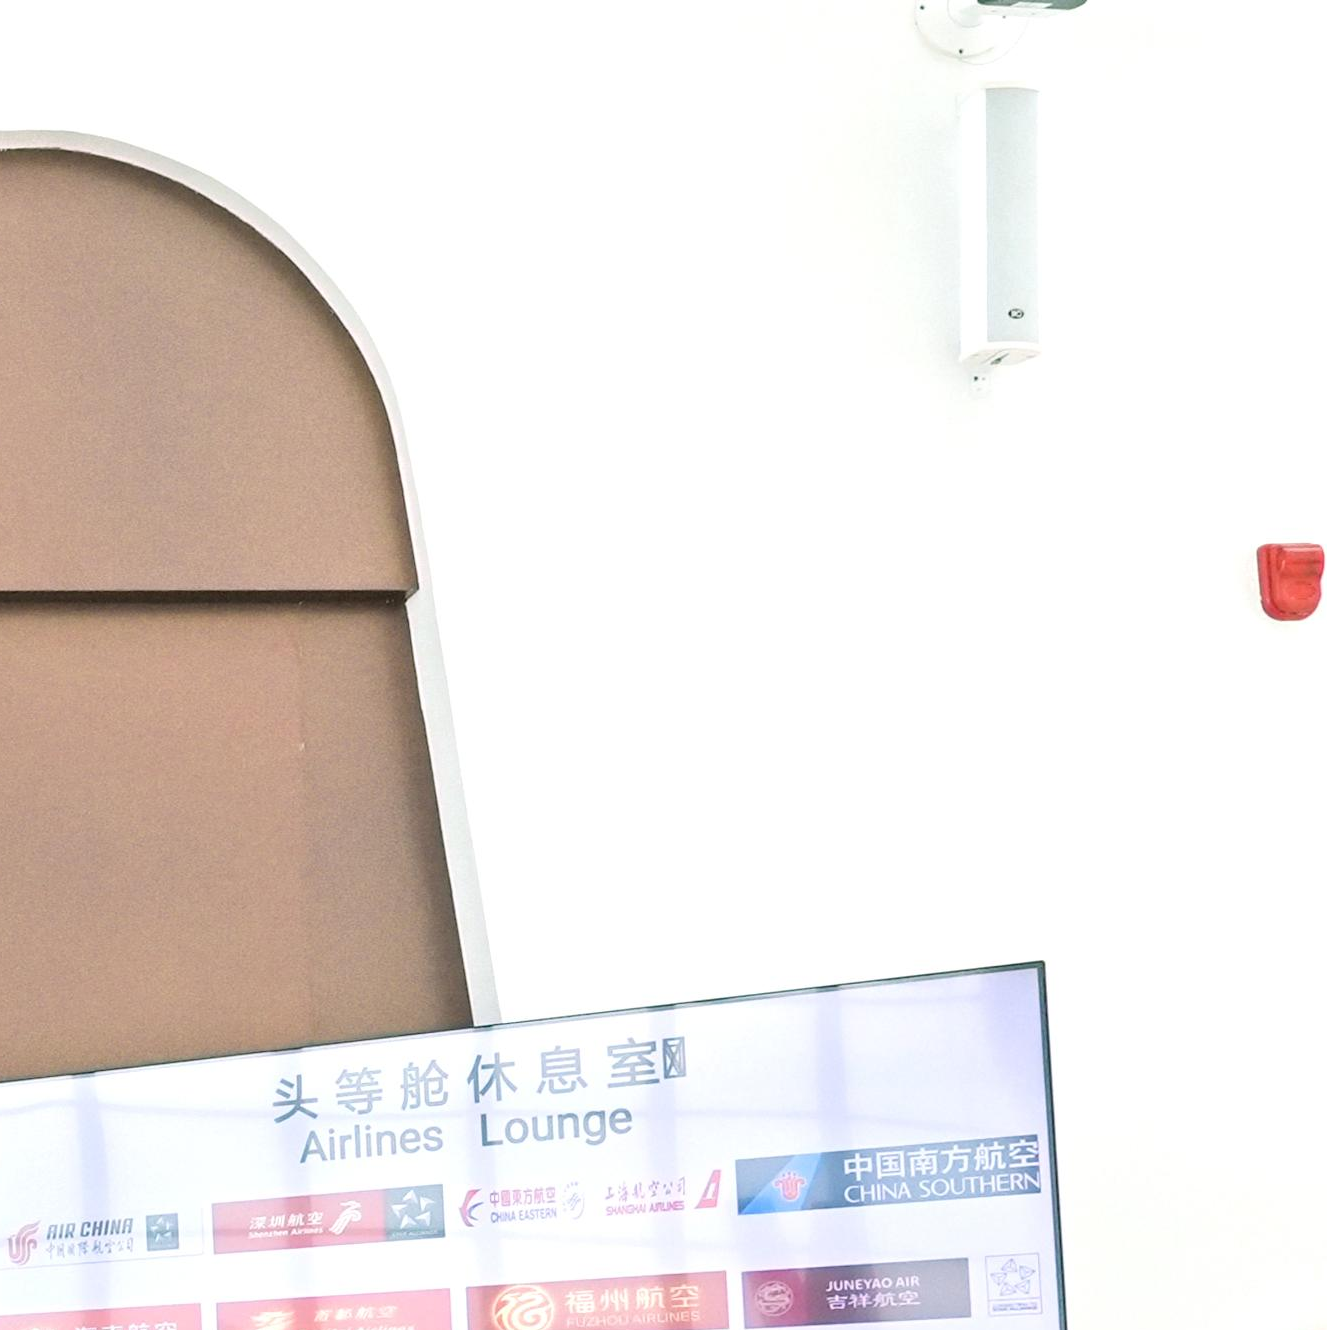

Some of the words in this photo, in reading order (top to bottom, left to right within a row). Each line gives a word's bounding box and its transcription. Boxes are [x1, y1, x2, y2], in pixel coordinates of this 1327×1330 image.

[273, 1037, 660, 1124] 头等舱休息室
[299, 1124, 444, 1164] Airlines
[479, 1107, 633, 1147] Lounge
[843, 1139, 1040, 1182] 中国南方航空
[844, 1182, 912, 1204] CHINA
[918, 1171, 1040, 1198] SOUTHERN
[249, 1210, 324, 1231] 深圳航空
[489, 1210, 517, 1224] CHINA
[518, 1207, 558, 1221] EASTERN
[605, 1203, 647, 1217] SHANGHAI
[46, 1223, 76, 1241] AIR
[79, 1217, 134, 1239] CHINA
[825, 1277, 893, 1292] JUNEYAO
[895, 1275, 921, 1287] AIR
[565, 1284, 699, 1314] 福州航空
[827, 1290, 922, 1310] 吉祥航空
[566, 1314, 629, 1329] FUZHOU
[631, 1310, 700, 1325] AIRLINES
